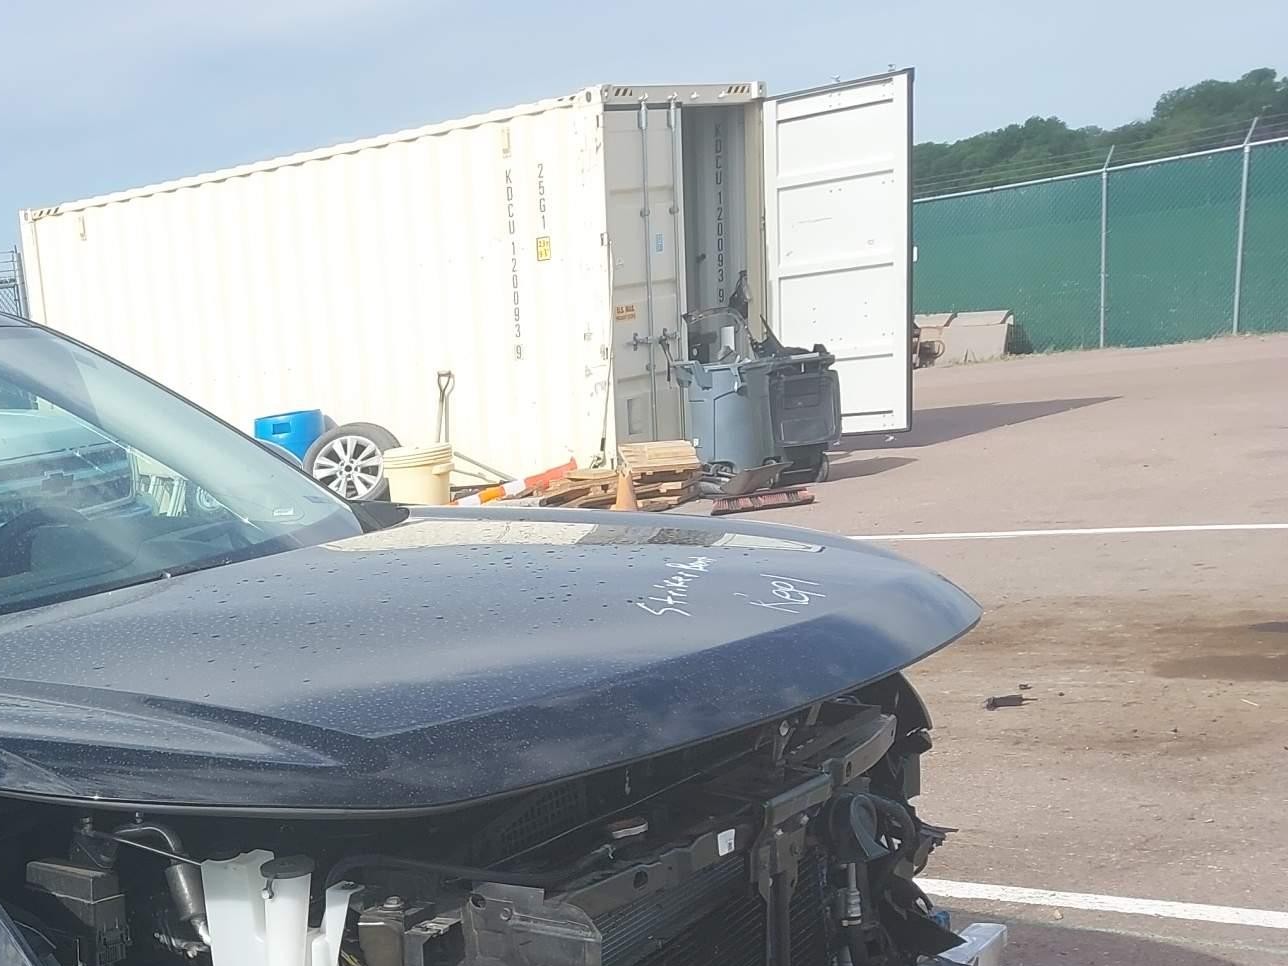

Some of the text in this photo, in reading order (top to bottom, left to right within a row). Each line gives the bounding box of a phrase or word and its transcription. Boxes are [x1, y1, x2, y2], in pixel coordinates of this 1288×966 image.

[537, 163, 547, 231] 25G1
[716, 191, 724, 283] 120093
[504, 168, 516, 234] KDCU
[510, 241, 522, 338] 120093
